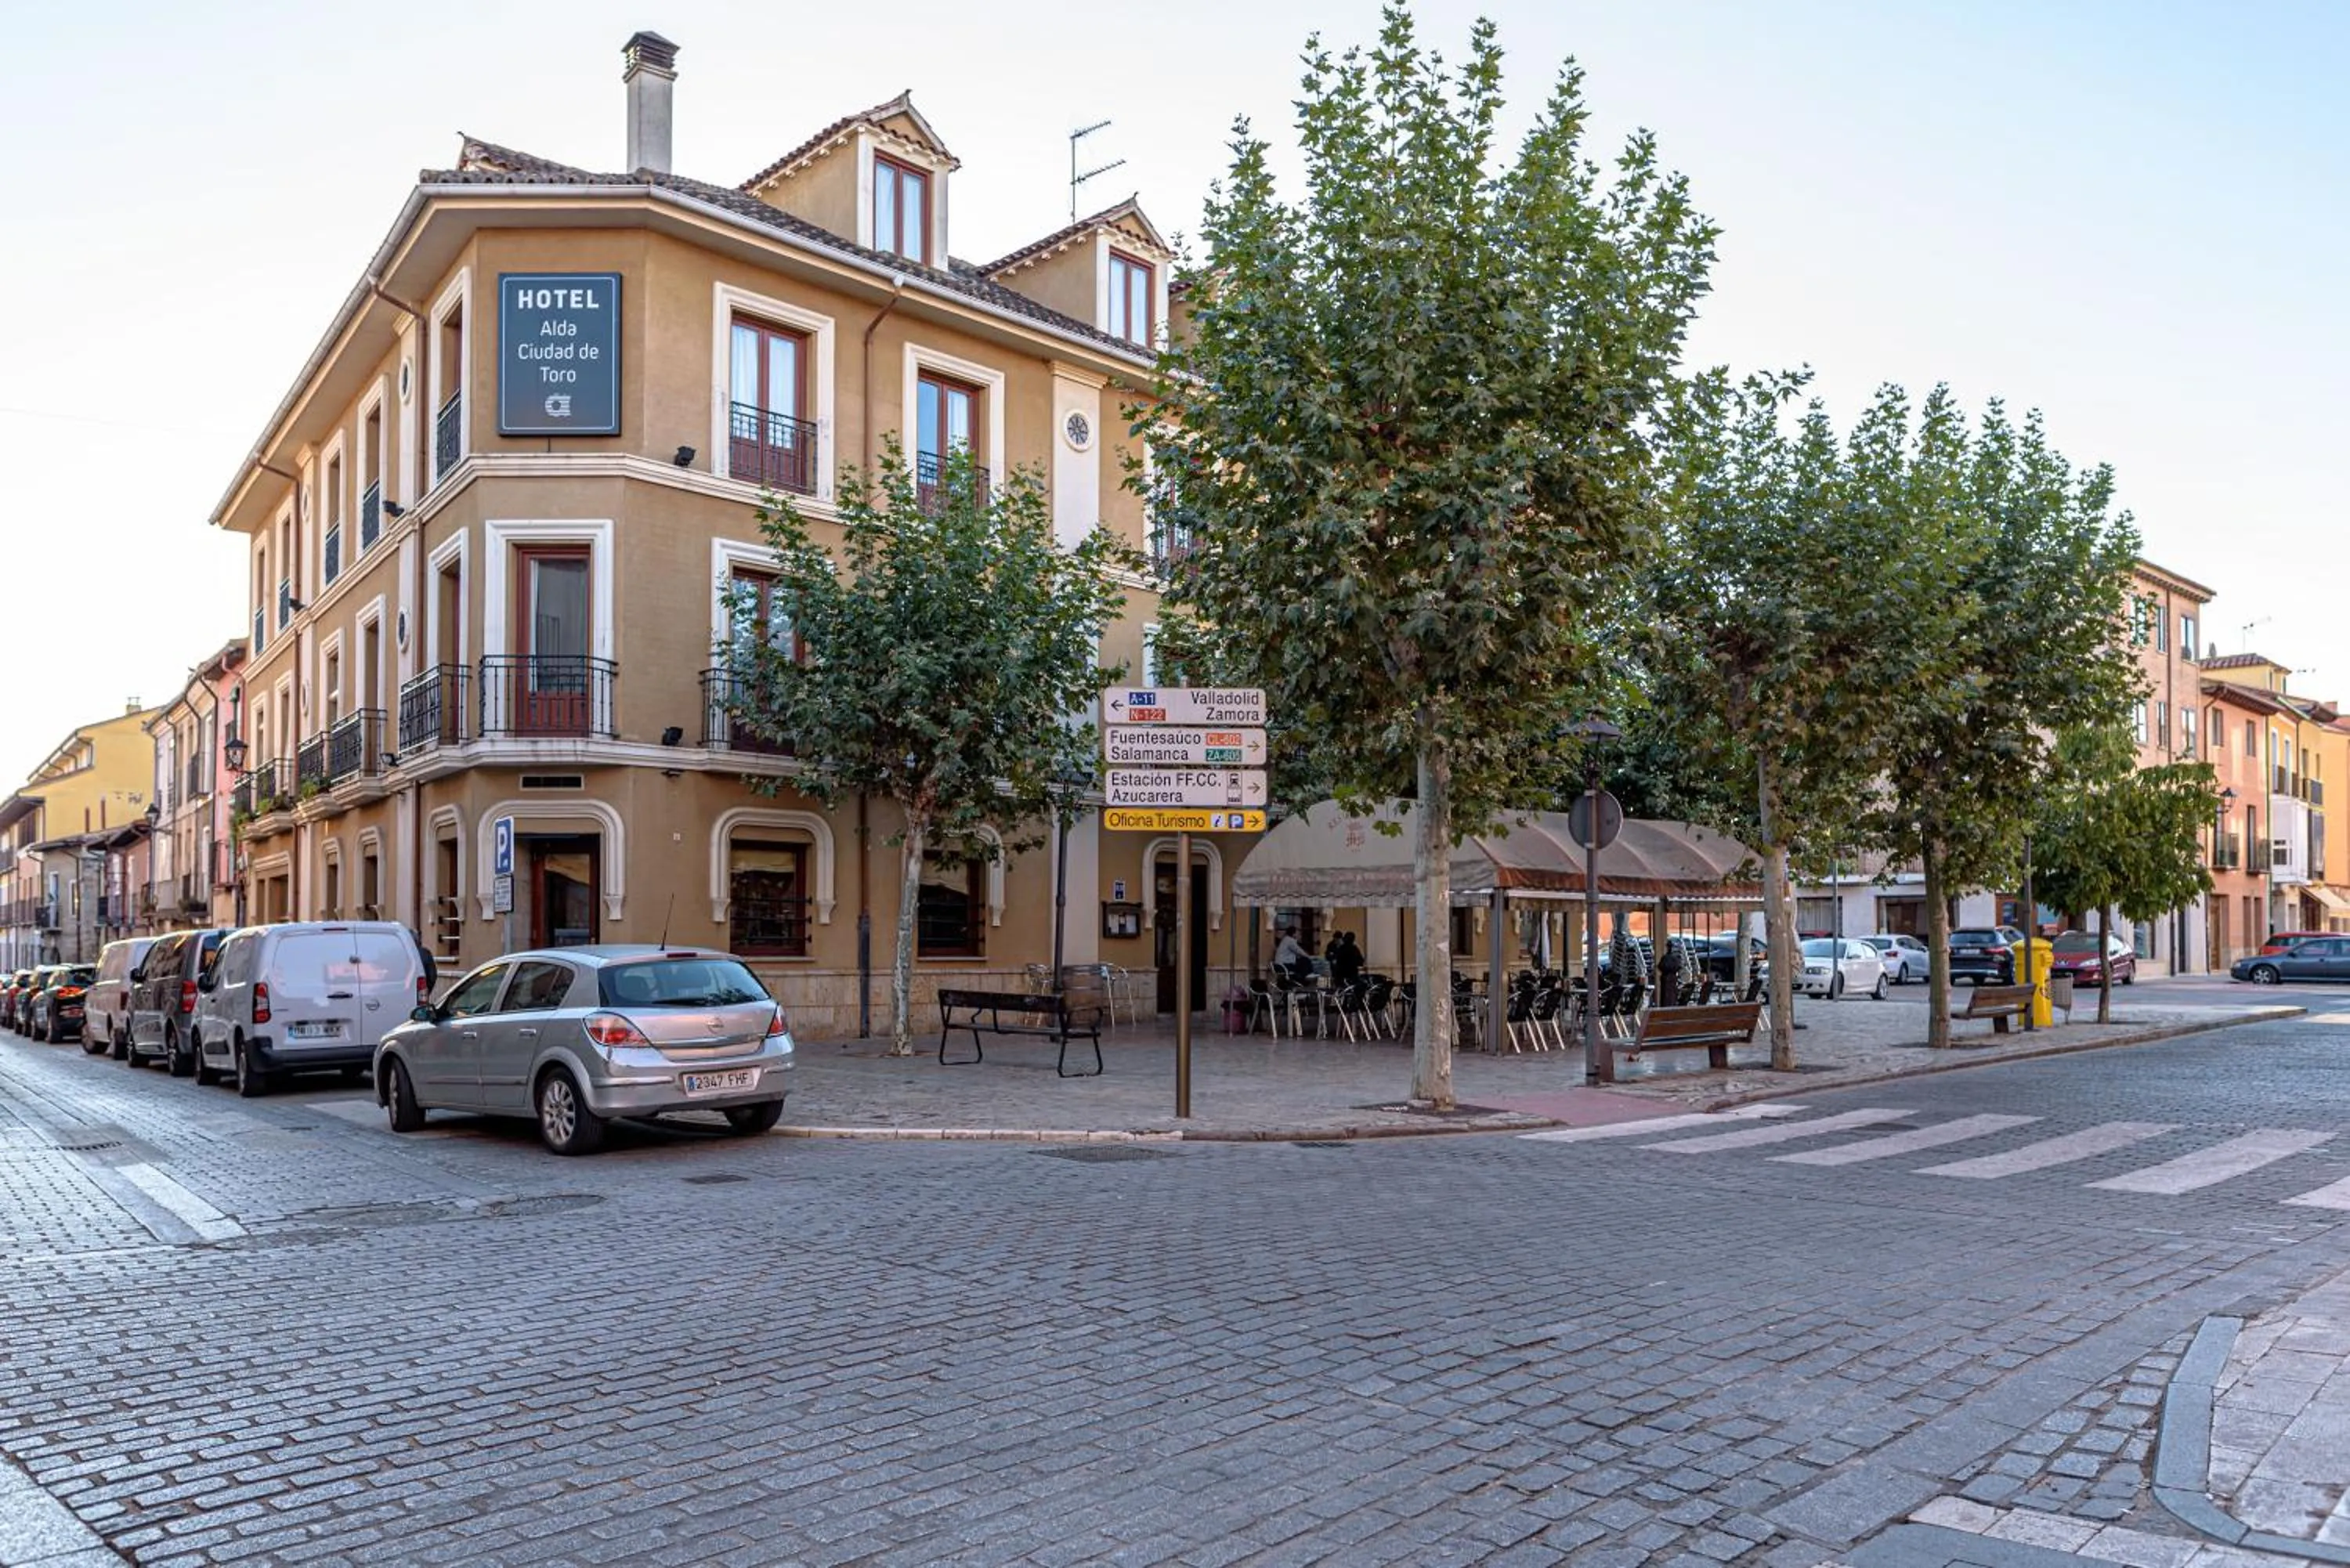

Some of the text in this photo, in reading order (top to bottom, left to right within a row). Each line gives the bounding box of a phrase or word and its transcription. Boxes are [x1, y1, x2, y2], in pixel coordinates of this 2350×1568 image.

[518, 289, 599, 309] HOTEL
[540, 320, 577, 336] Alda
[518, 343, 599, 359] Ciudad de
[540, 367, 577, 382] Toro
[1130, 694, 1154, 704] A-11
[1191, 691, 1259, 705] Valladolid
[1130, 709, 1163, 720] N-122
[1206, 707, 1260, 721] Zamora
[1110, 730, 1201, 745] Fuentesaúco
[1111, 746, 1189, 761] Salamanca
[1112, 771, 1221, 787] Estación FF.CC.
[1112, 789, 1183, 803] Azucarera
[1108, 812, 1206, 827] Oficina Turismo
[1231, 815, 1242, 828] P
[497, 826, 508, 869] P
[696, 1075, 723, 1089] 2347
